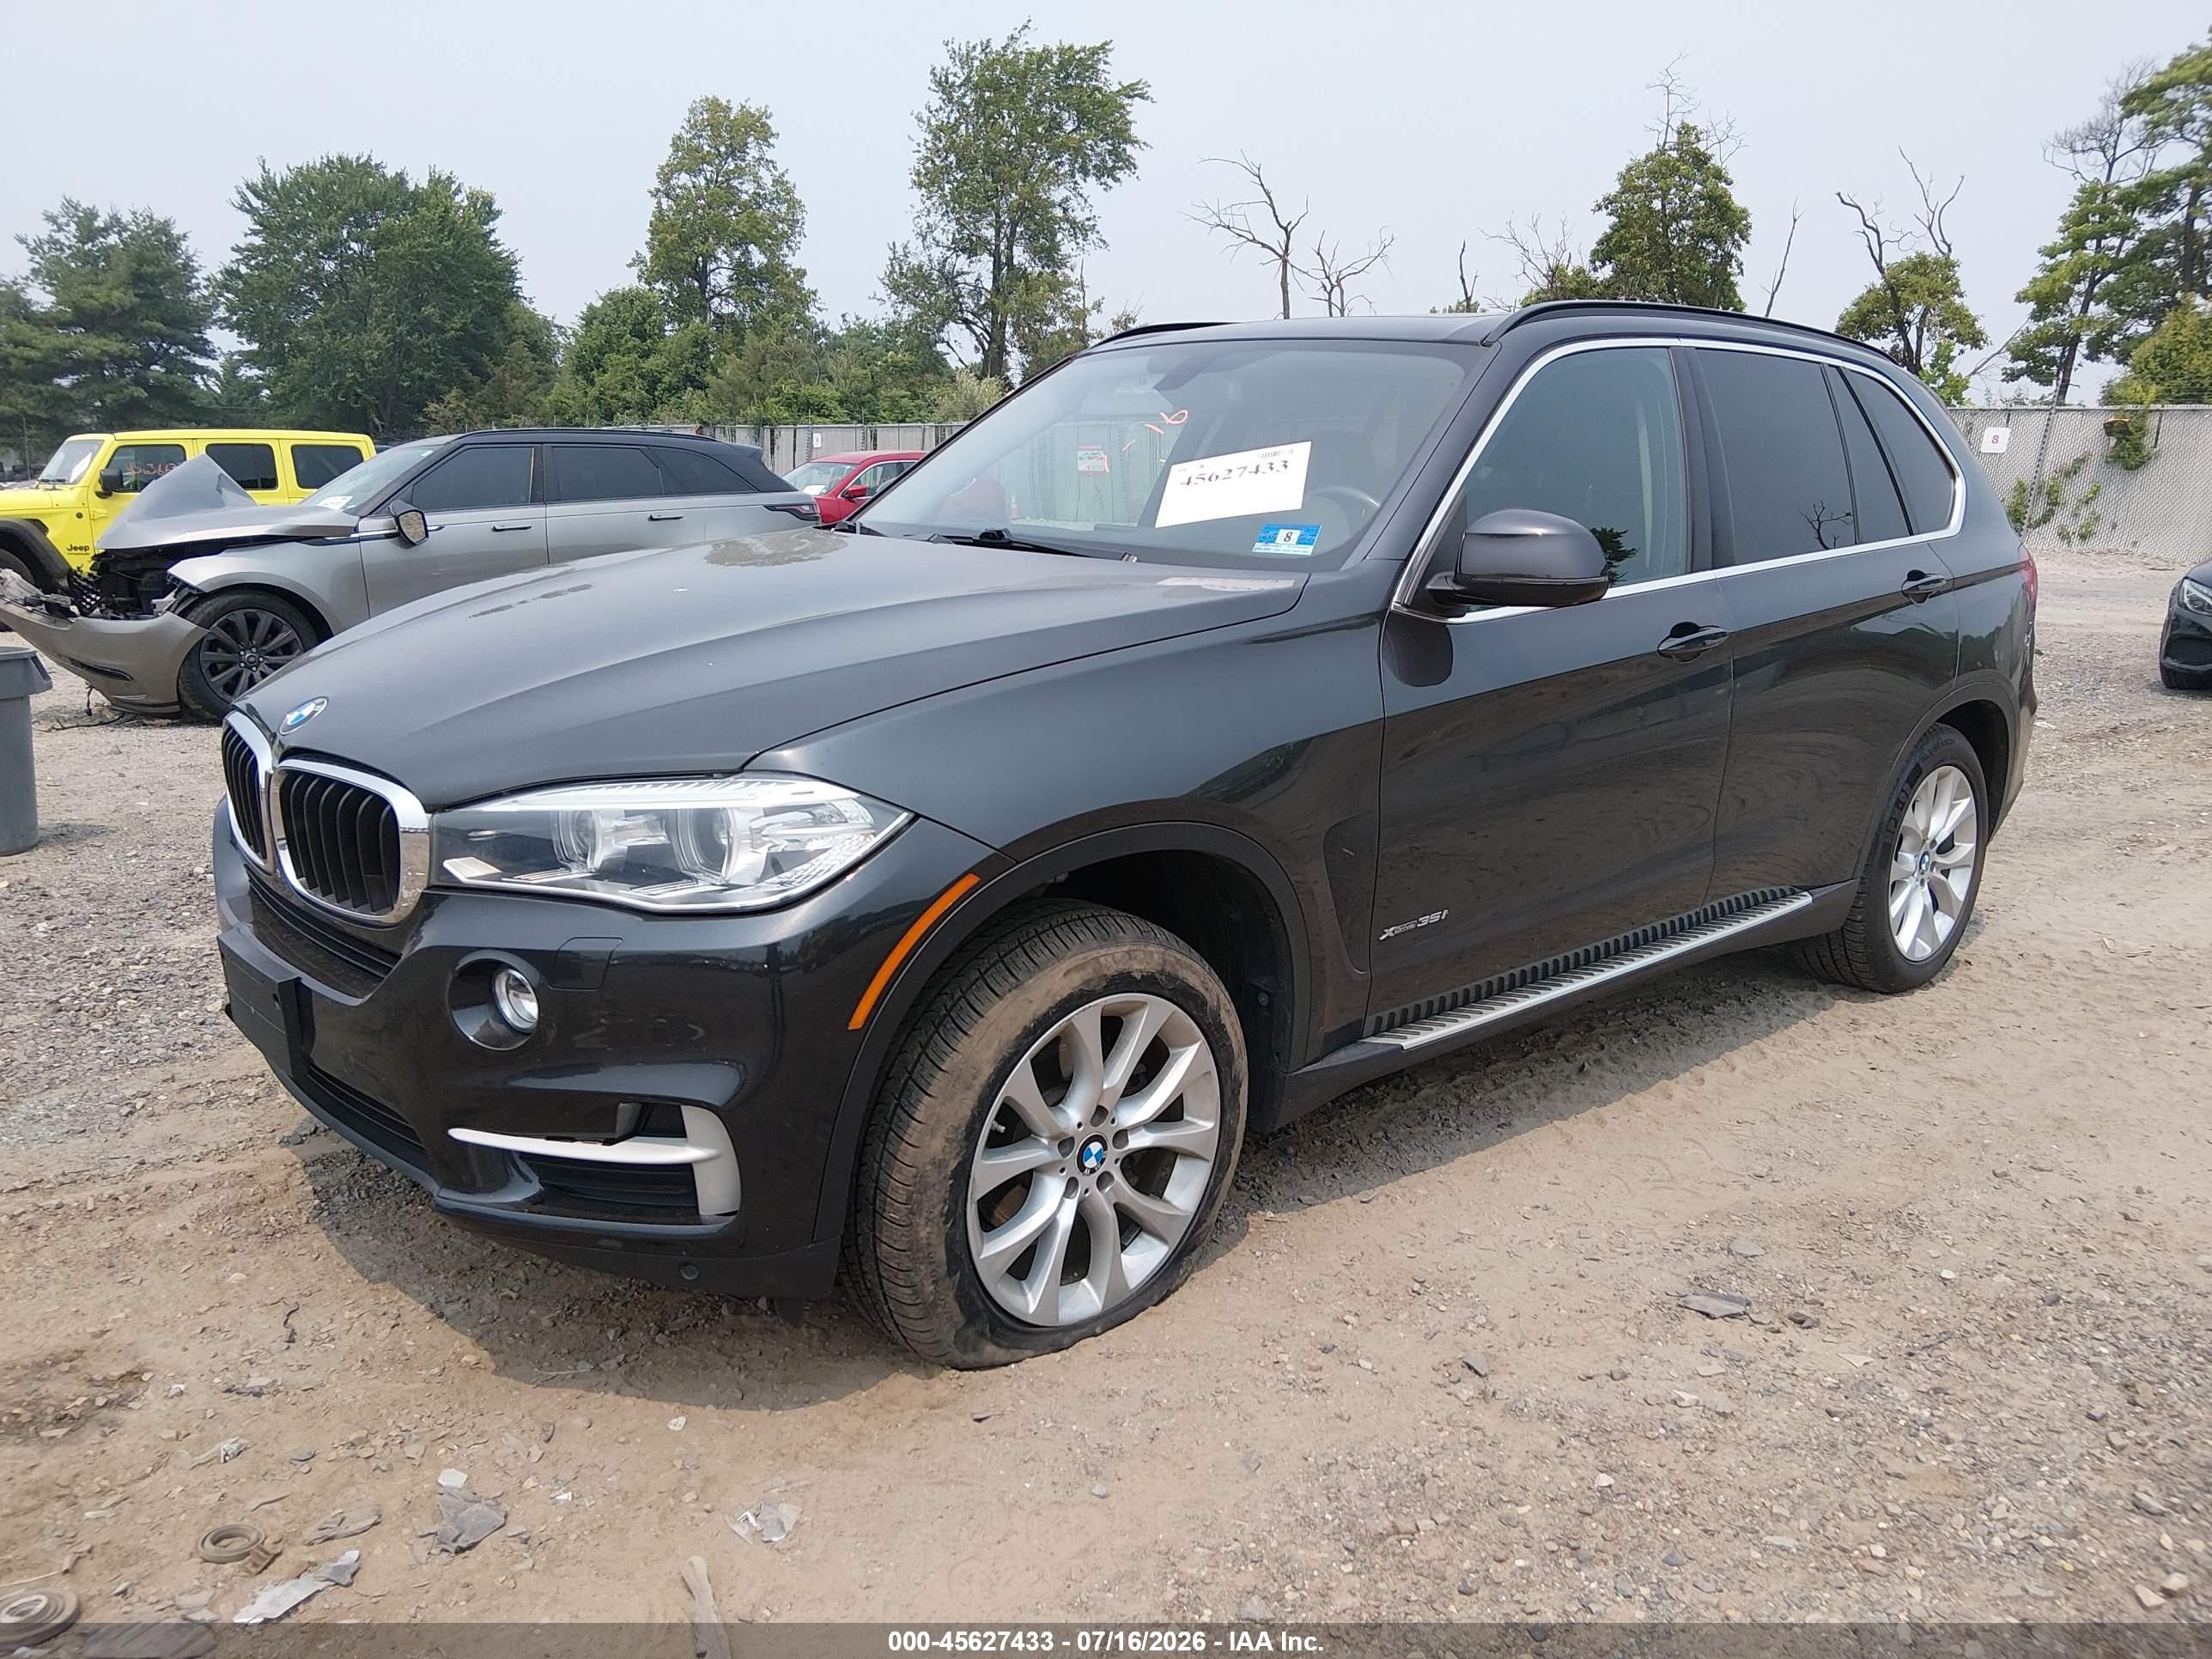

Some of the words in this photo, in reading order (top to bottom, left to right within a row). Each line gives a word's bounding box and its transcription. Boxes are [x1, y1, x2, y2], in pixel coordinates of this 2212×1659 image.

[1991, 434, 2000, 444] 8
[1181, 459, 1289, 487] 45627433
[1283, 531, 1293, 543] 8
[66, 544, 90, 552] Jeep
